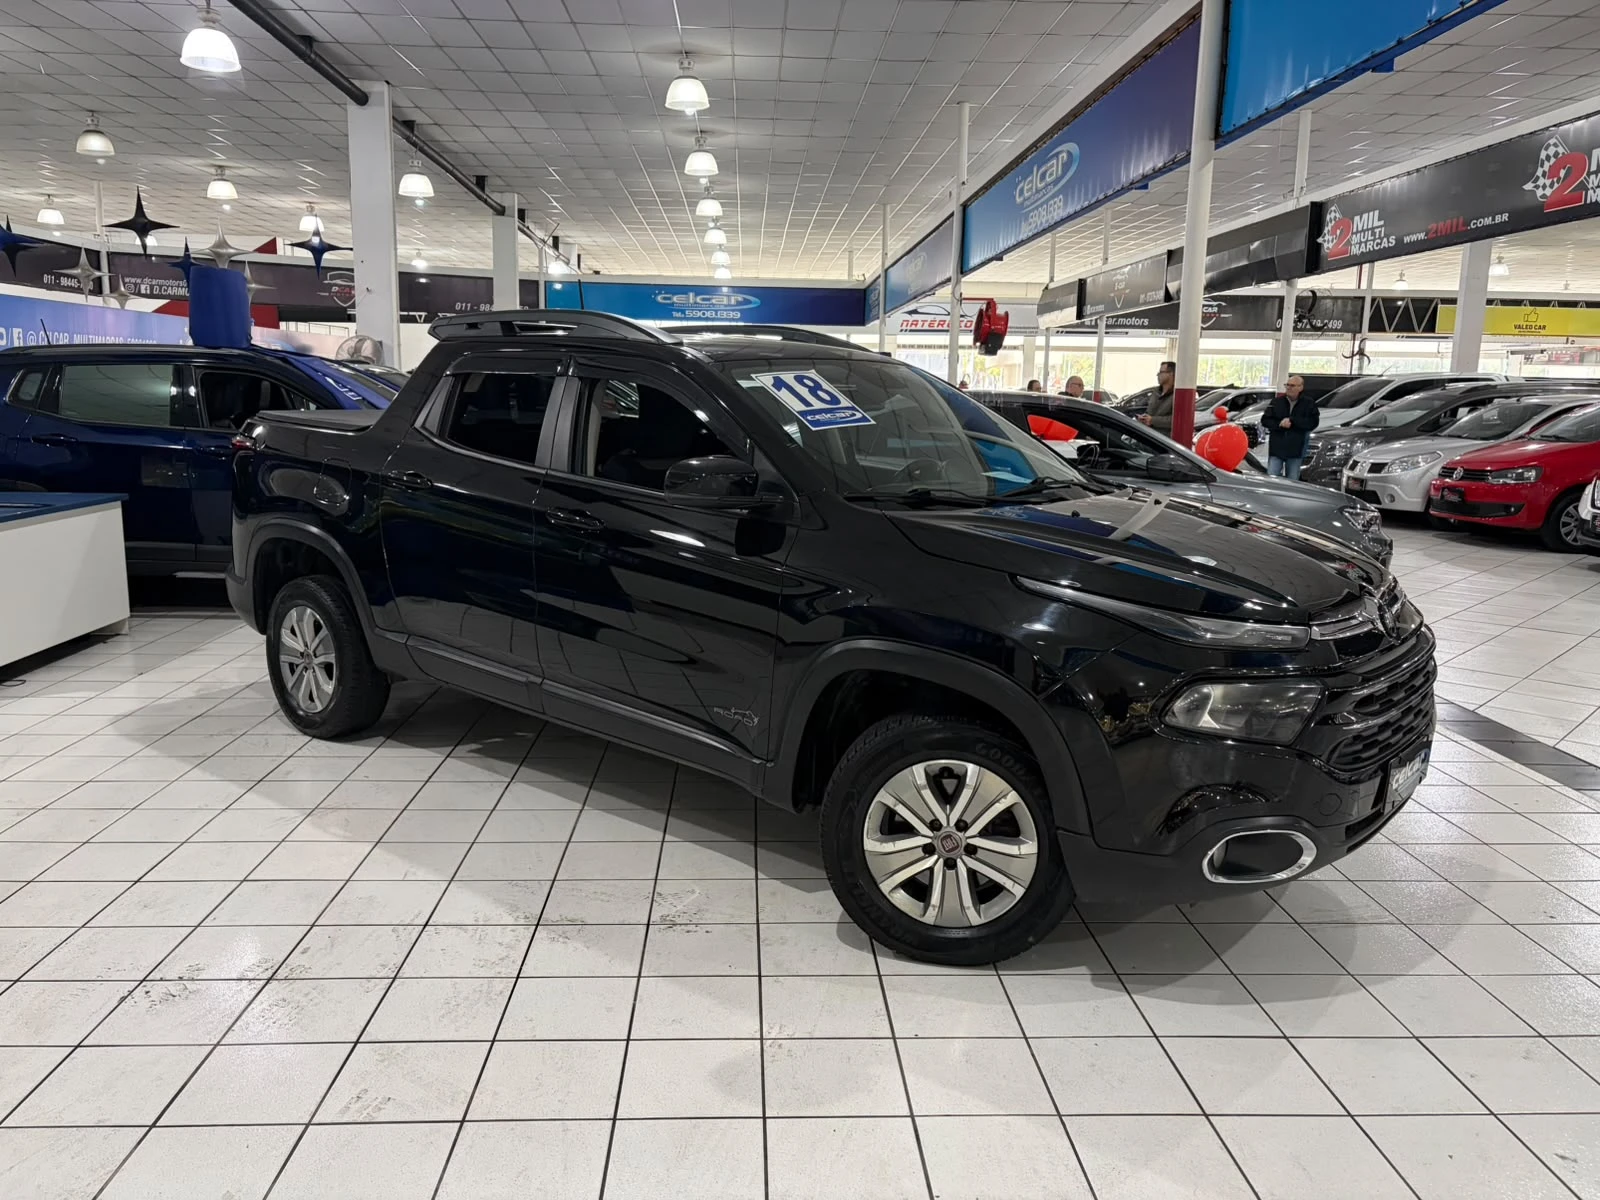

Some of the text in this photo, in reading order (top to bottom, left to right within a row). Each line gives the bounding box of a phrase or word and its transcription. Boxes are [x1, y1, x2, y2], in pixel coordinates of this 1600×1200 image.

[1015, 151, 1068, 204] celcar
[1543, 151, 1589, 213] 2
[1353, 209, 1385, 232] MIL
[1327, 216, 1353, 261] 2
[1350, 235, 1397, 256] MARCAS
[1351, 226, 1385, 245] MULTI
[43, 273, 55, 284] 011
[60, 276, 94, 291] 98445-0
[455, 302, 471, 311] 011
[656, 291, 744, 306] celcar
[771, 374, 842, 407] 18
[806, 410, 856, 421] celcar
